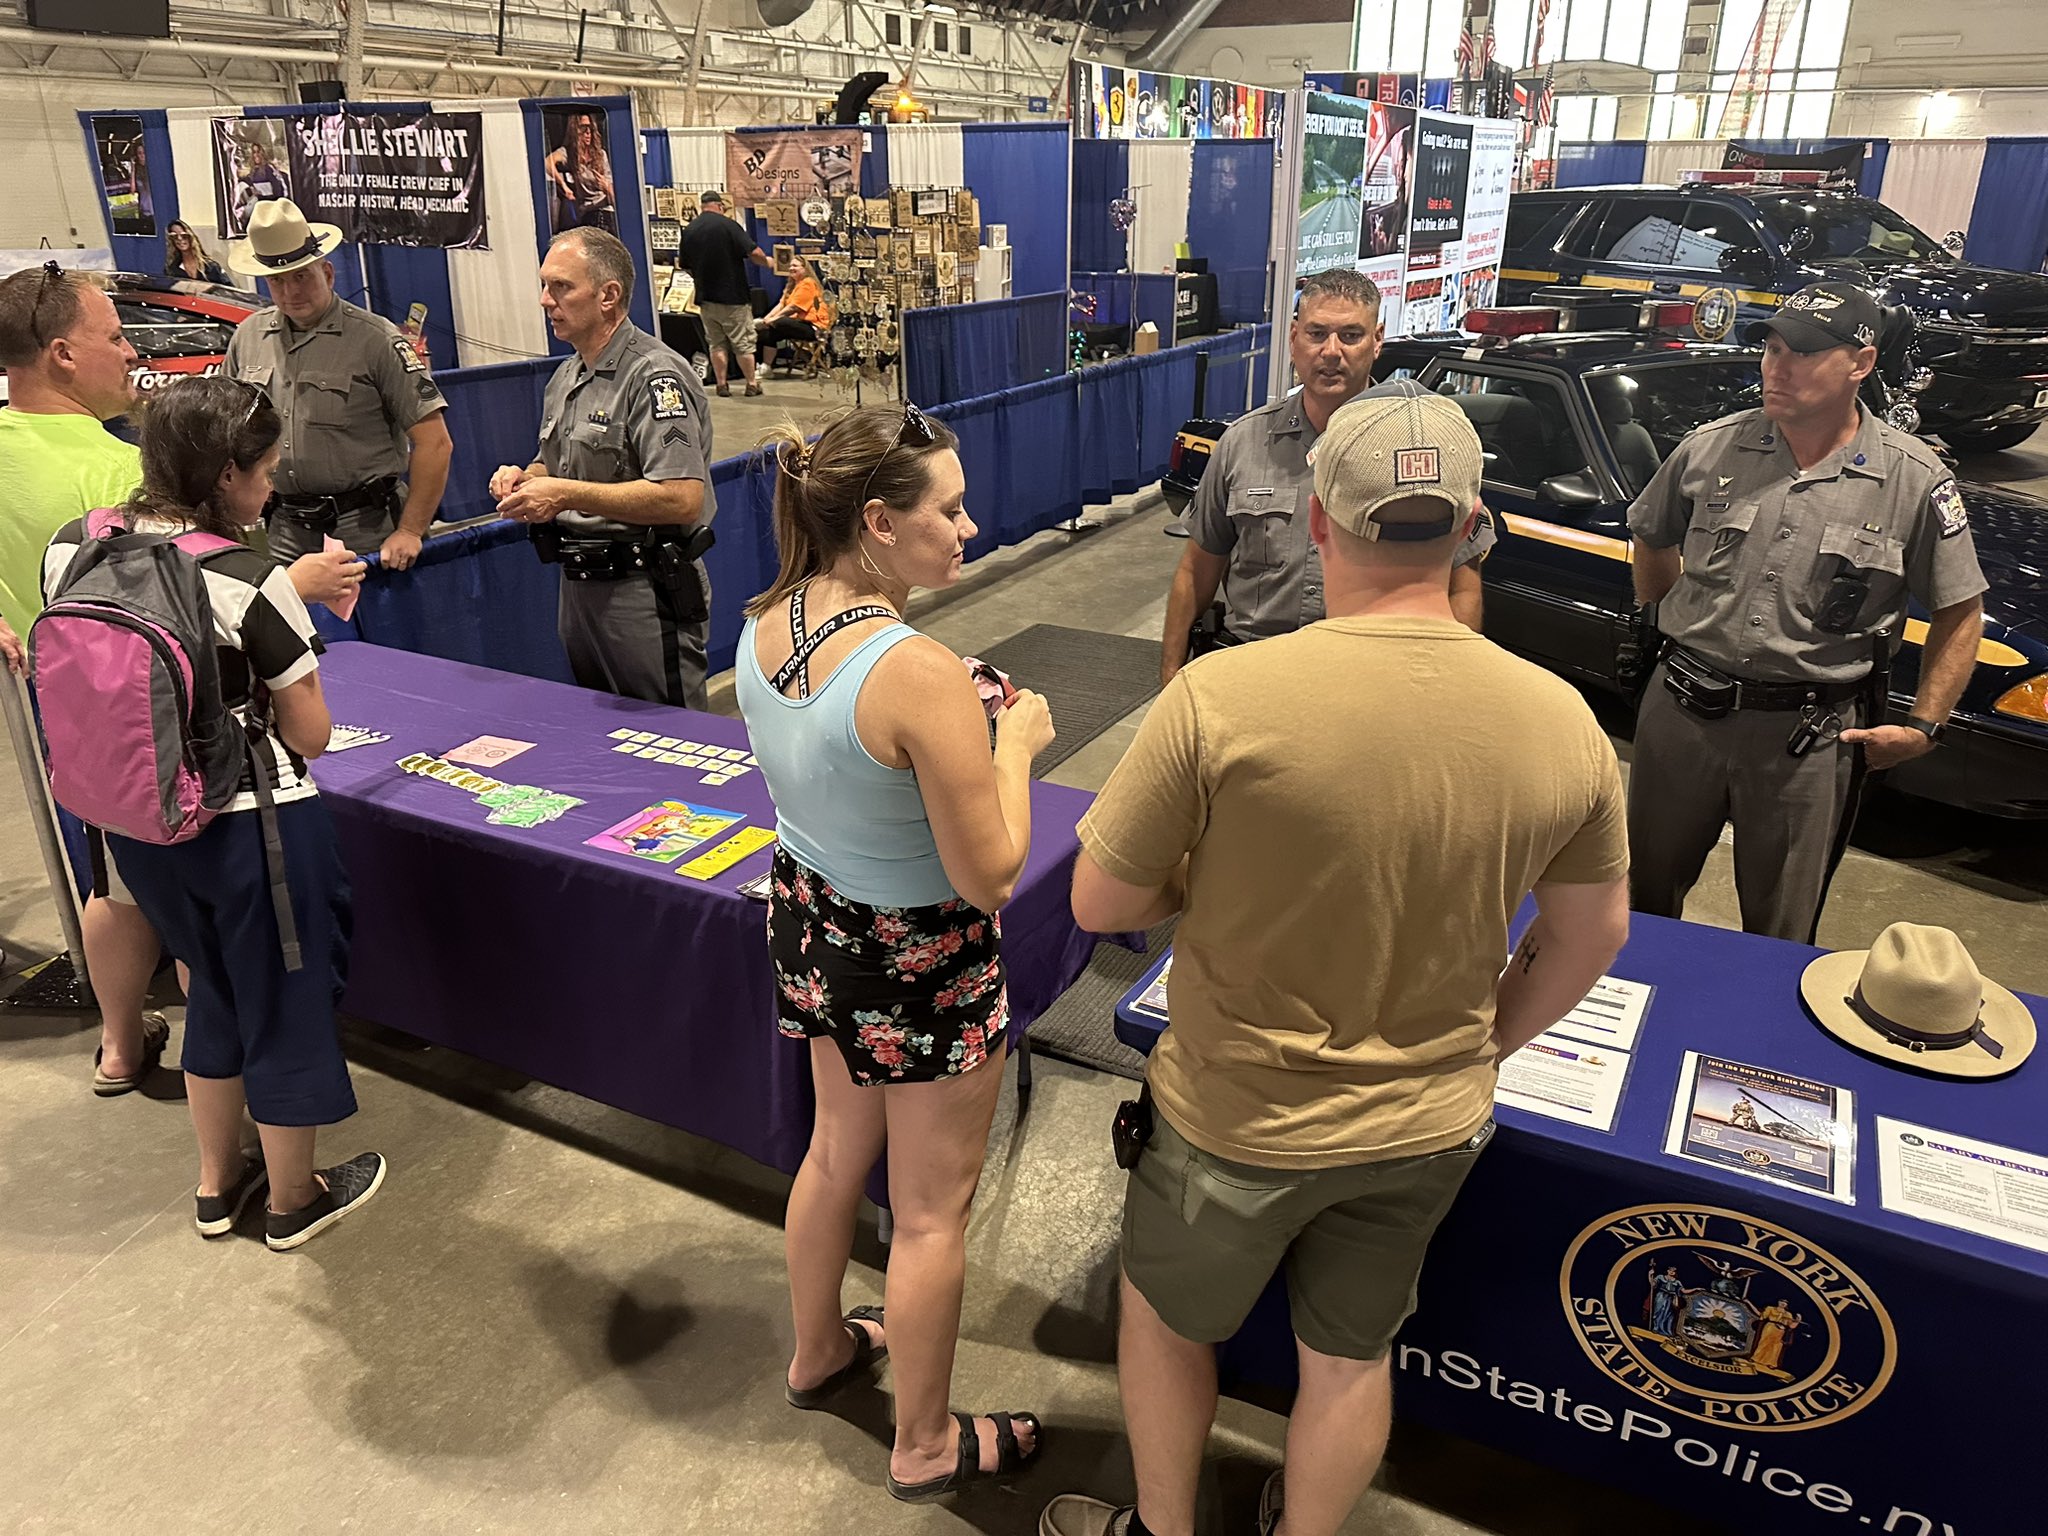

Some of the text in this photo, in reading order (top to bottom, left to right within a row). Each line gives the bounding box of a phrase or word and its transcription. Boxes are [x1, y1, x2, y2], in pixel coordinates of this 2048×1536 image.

[302, 129, 468, 158] SHELLIE STEWART
[319, 174, 463, 192] THE ONLY FEMALE CREW CHIEF IN
[756, 167, 800, 183] Designs
[318, 193, 469, 213] NASCAR HISTORY, HEAD MECHANIC
[778, 620, 836, 687] ARMOUR
[1707, 1060, 1825, 1092] Join the New York State Police
[1928, 1142, 1974, 1159] SALARY
[1976, 1155, 2001, 1165] AND
[1605, 1213, 1869, 1315] NEW YORK
[1572, 1297, 1865, 1424] STATE POLICE
[1675, 1350, 1742, 1373] EXCELSIOR
[1400, 1344, 1955, 1536] nStatePolice.n
